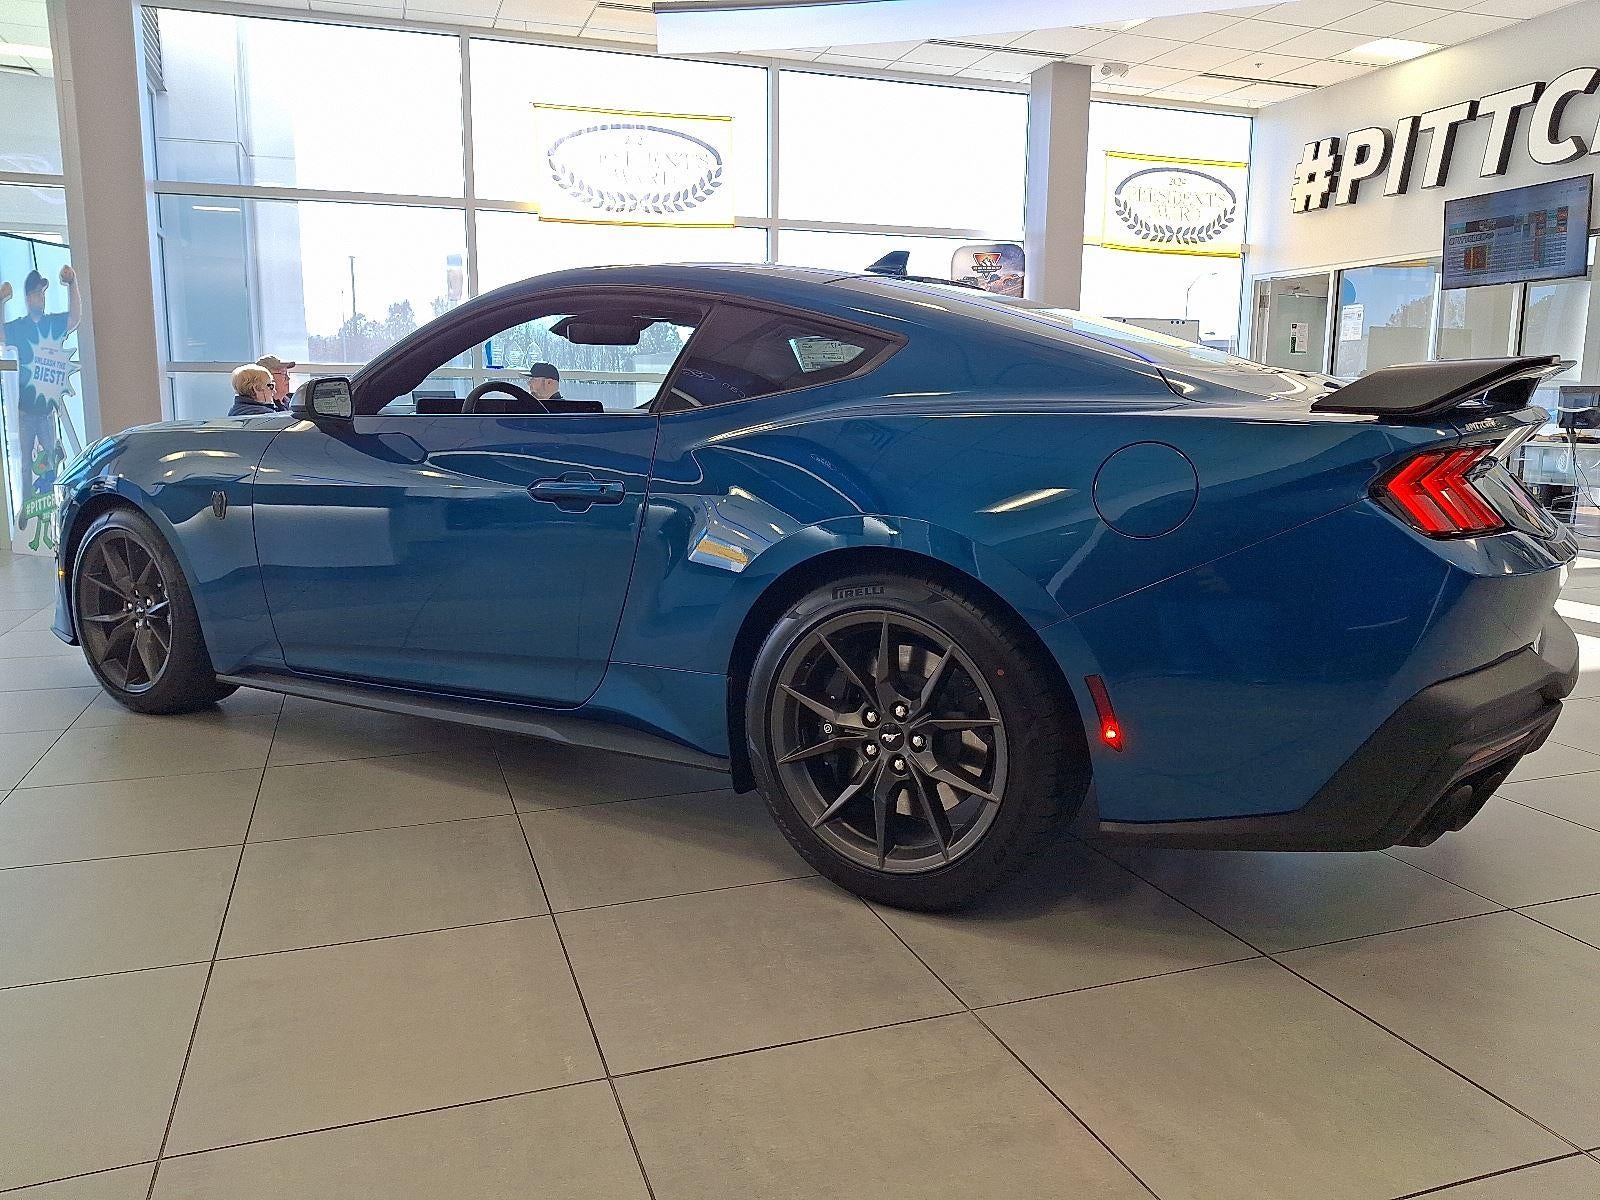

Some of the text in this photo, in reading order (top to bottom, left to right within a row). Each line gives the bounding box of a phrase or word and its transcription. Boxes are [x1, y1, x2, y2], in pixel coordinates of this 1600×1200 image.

[1290, 66, 1600, 213] #PITTC
[34, 356, 67, 370] UNLEASH THE
[33, 366, 66, 386] BIEST!
[831, 585, 886, 601] PIRELLI
